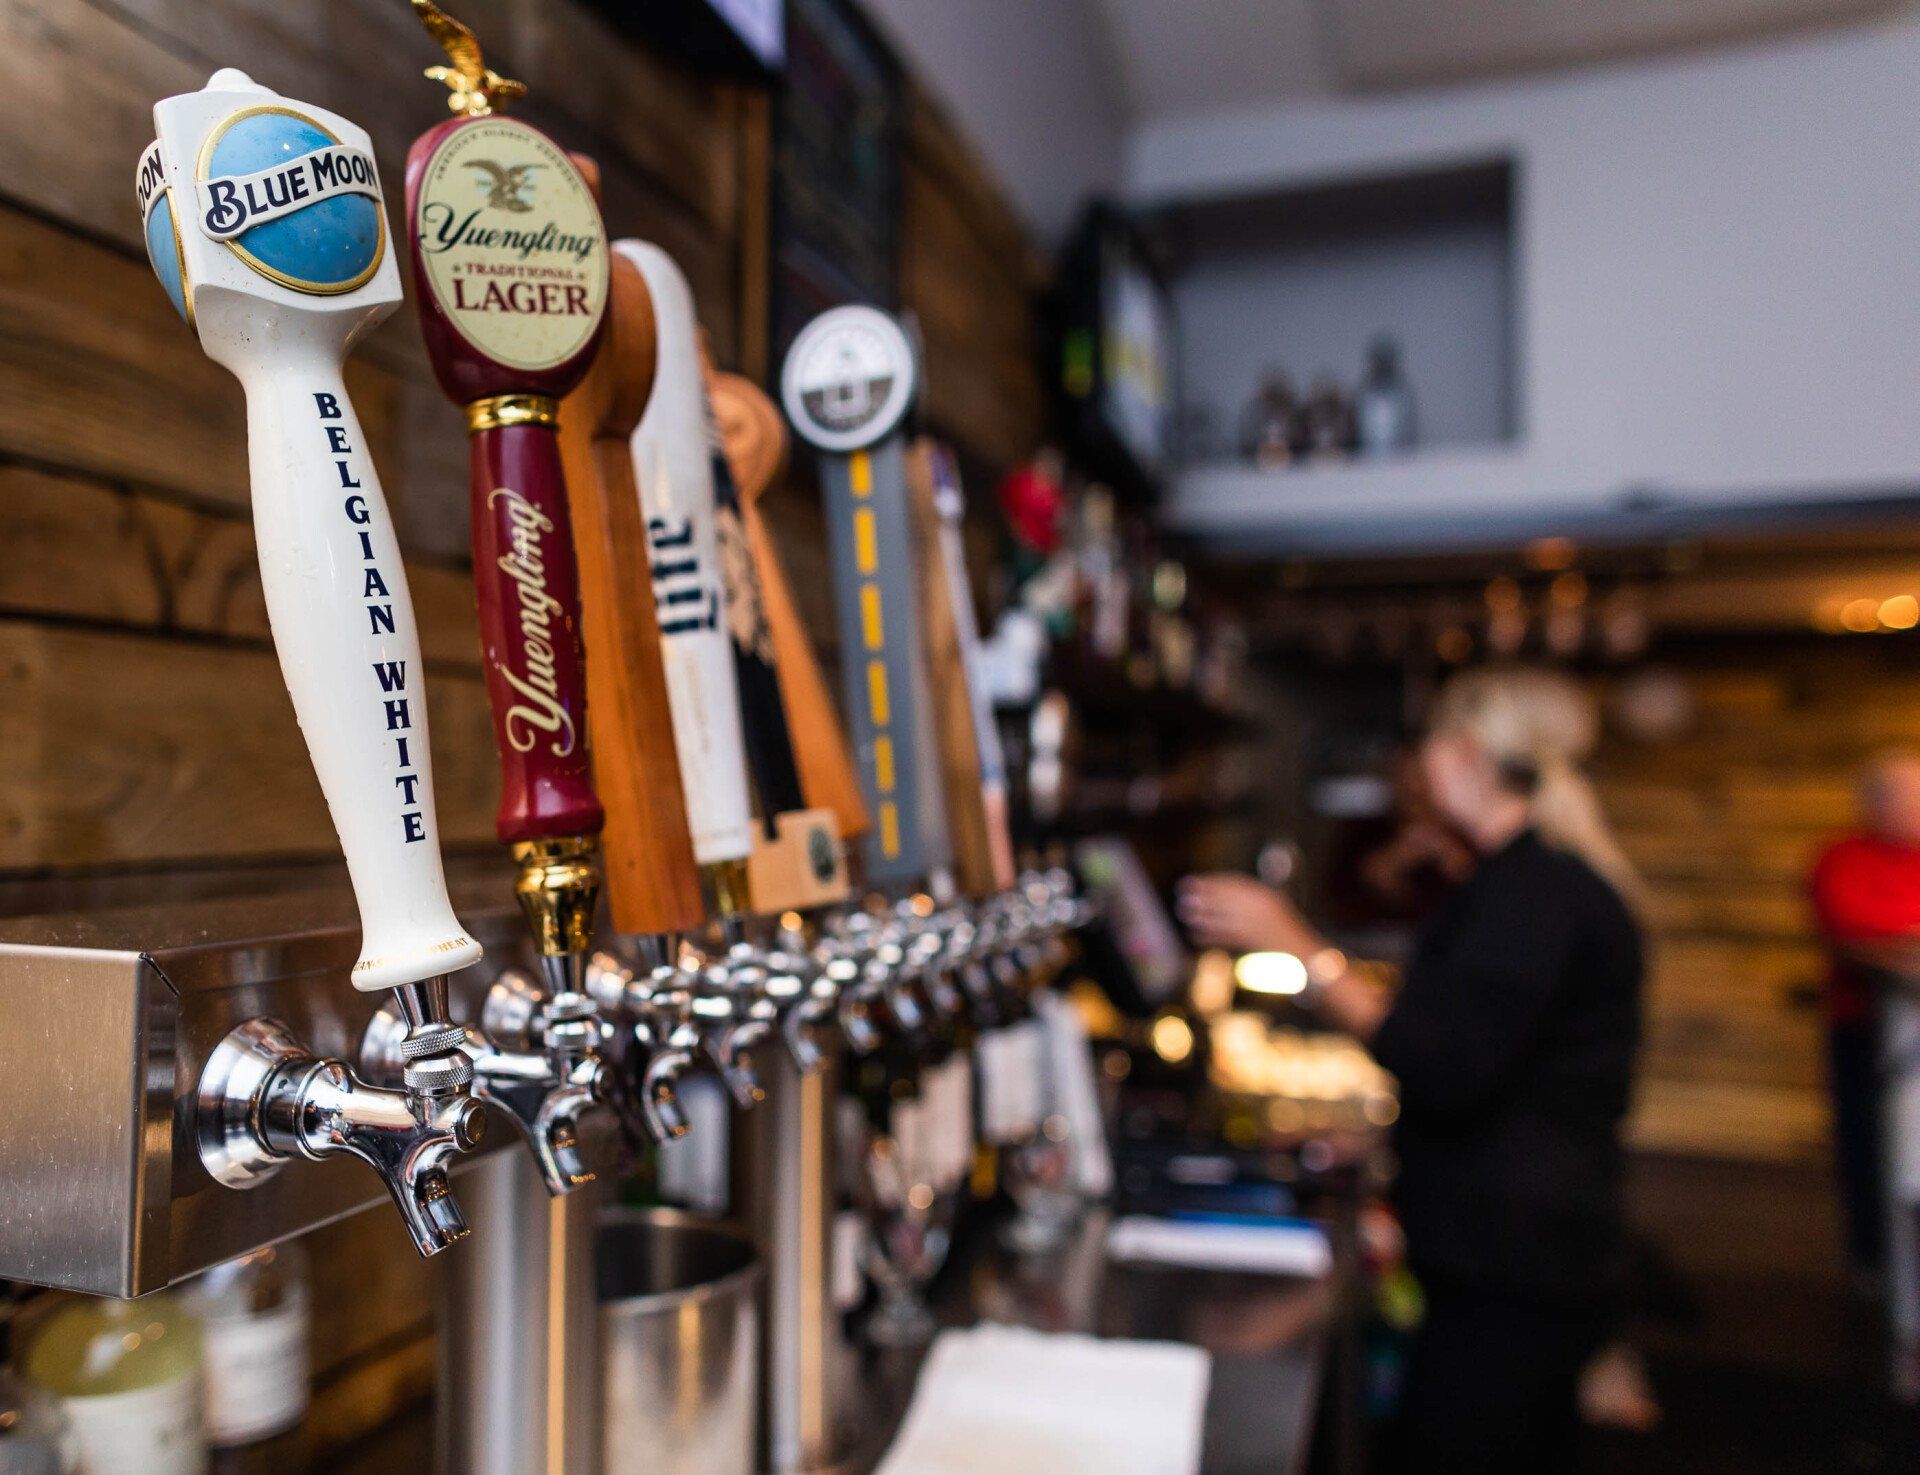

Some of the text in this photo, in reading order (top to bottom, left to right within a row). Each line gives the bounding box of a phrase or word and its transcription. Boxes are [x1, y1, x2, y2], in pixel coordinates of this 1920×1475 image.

[205, 165, 310, 234] BLUE
[309, 152, 379, 192] MOON
[418, 202, 597, 264] Yuengling
[452, 279, 590, 316] LAGER
[465, 262, 573, 279] TRADITIONAL
[313, 392, 426, 844] BELGIAN WHITE
[487, 487, 575, 757] Yuengling
